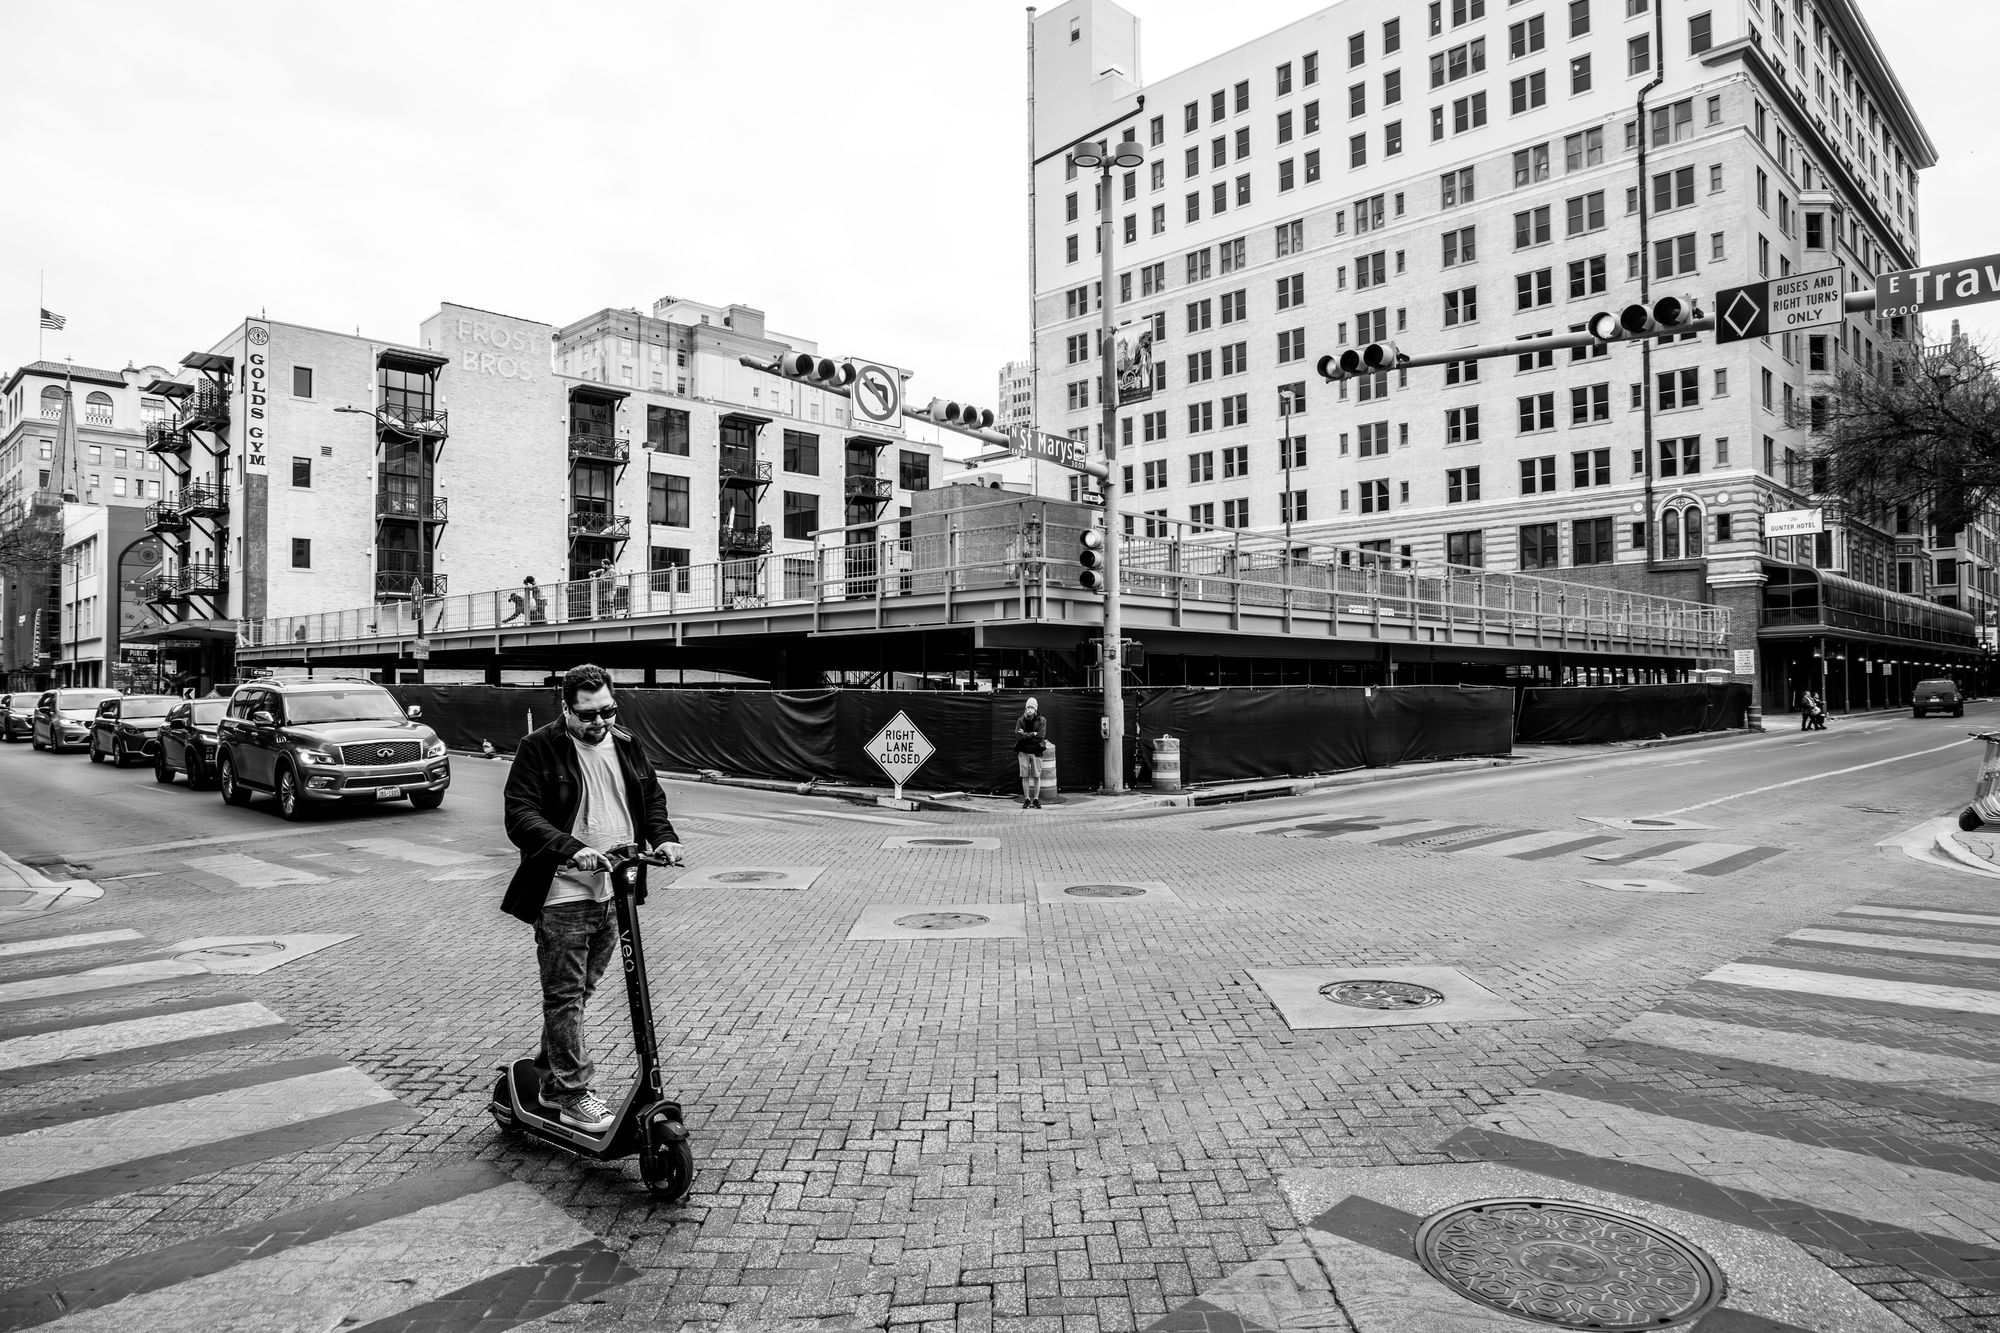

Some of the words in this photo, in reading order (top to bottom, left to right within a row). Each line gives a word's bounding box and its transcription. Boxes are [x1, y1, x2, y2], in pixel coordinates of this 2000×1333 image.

[1777, 280, 1808, 296] BUSES
[1814, 275, 1834, 289] AND
[1889, 276, 1900, 294] E
[1909, 265, 2000, 304] Trav
[1773, 297, 1801, 312] RIGHT
[1806, 290, 1838, 306] TURNS
[1889, 304, 1919, 317] 200
[1787, 308, 1822, 324] ONLY
[458, 319, 541, 353] FROST
[462, 349, 537, 382] BROS.
[250, 354, 266, 419] GOLDS
[249, 427, 266, 466] GYM
[1011, 426, 1017, 438] N
[1020, 429, 1032, 451] St
[1038, 432, 1073, 464] Marys
[1771, 524, 1795, 532] GUNTER
[129, 649, 149, 657] PUBLIC
[885, 729, 916, 740] RIGHT
[886, 741, 914, 753] LANE
[880, 753, 920, 764] CLOSED
